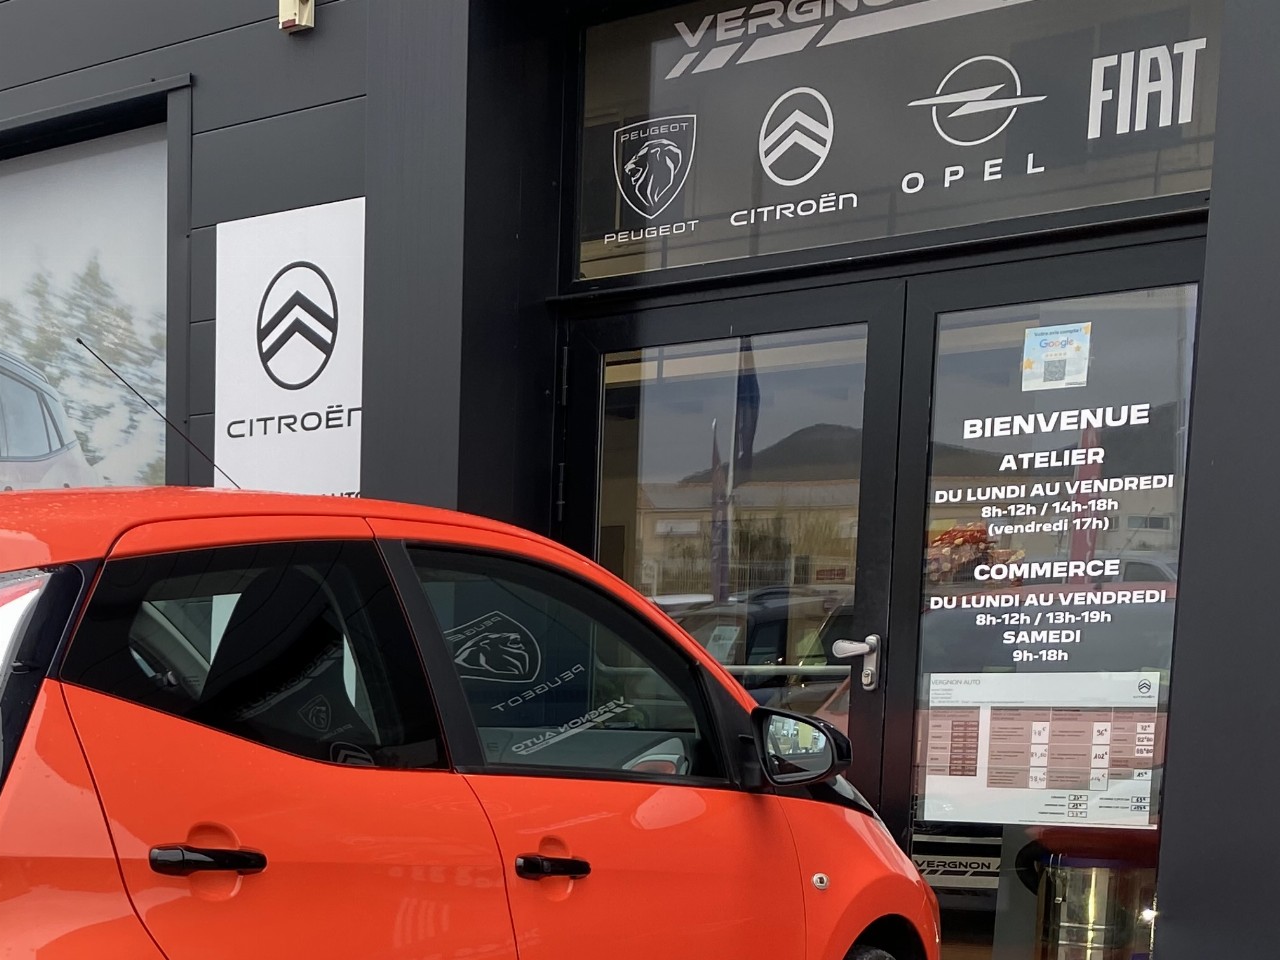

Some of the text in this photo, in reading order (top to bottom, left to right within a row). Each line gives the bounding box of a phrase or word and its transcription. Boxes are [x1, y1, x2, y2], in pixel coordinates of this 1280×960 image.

[674, 0, 894, 48] VERGN
[1087, 38, 1207, 139] FIAT
[620, 122, 689, 143] PEUGEOT
[902, 152, 1045, 194] OPEL
[604, 219, 699, 244] PEUGEOT
[1039, 337, 1074, 348] Google
[962, 403, 1151, 439] BIENVENUE
[999, 447, 1105, 471] ATELIER
[934, 474, 1175, 504] DU LUNDI AU VENDREDI
[981, 498, 1119, 519] 8h-12h / 14h-18h
[988, 517, 1110, 537] (vendredi 17h)
[973, 559, 1121, 581] COMMERCE
[930, 589, 1167, 610] DU LUNDI AU VENDREDI
[975, 609, 1112, 626] 8h-12h / 13h-19h
[1002, 629, 1081, 644] SAMEDI
[1012, 648, 1069, 663] 9h-18h
[914, 860, 991, 870] VERGNON
